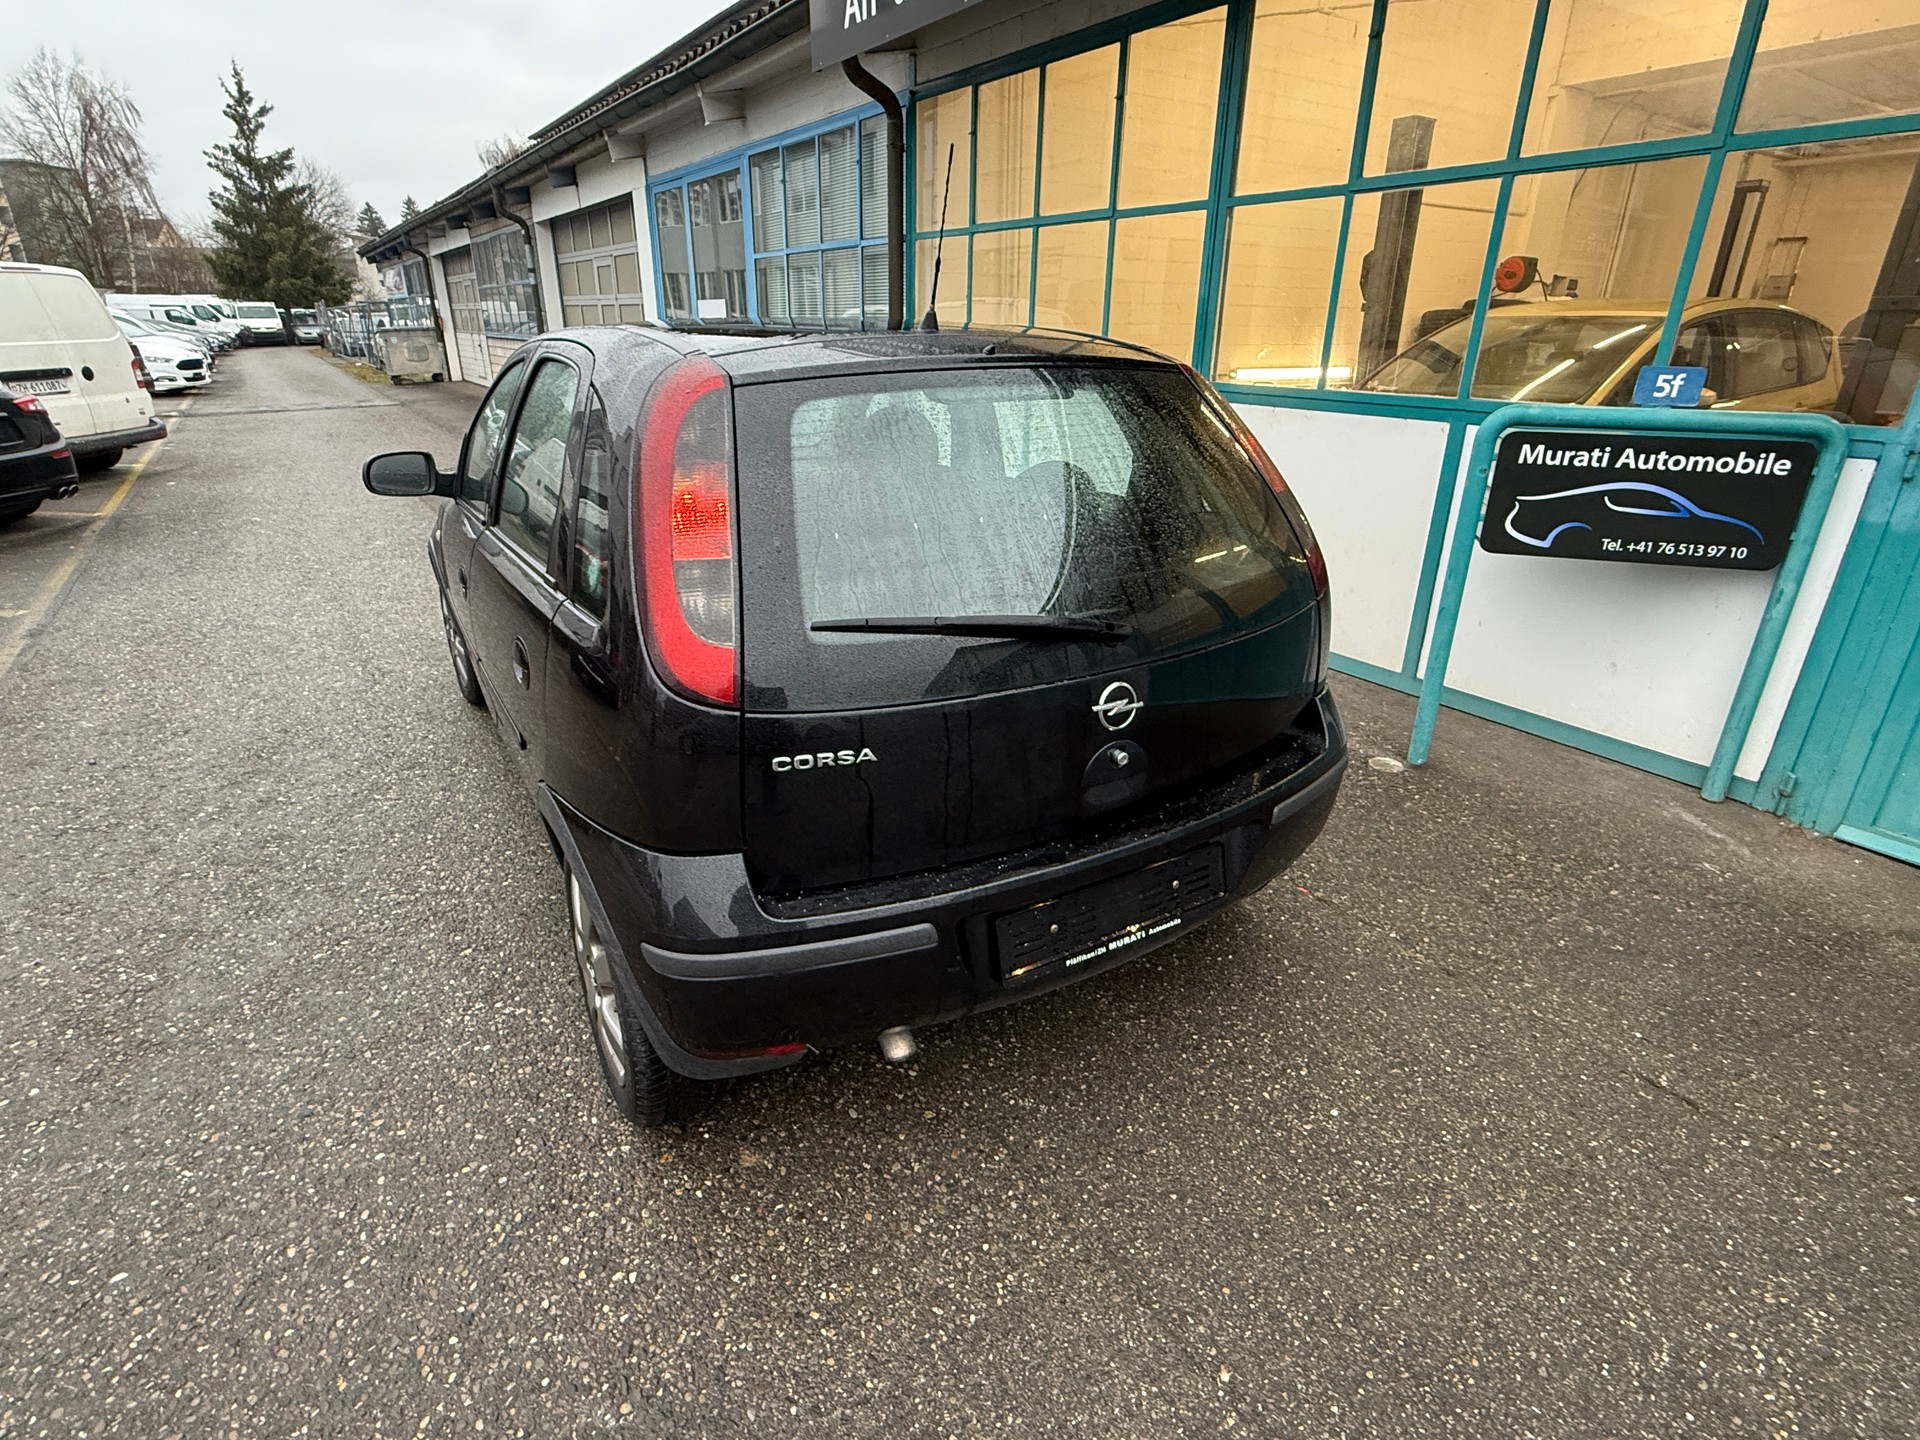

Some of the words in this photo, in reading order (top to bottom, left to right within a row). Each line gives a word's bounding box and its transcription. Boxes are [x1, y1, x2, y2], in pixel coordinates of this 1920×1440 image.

[1652, 373, 1687, 398] 5f
[1517, 443, 1611, 468] Murati
[1614, 447, 1792, 476] Automobile
[1601, 538, 1623, 551] Tel.
[1626, 541, 1653, 553] +41
[1657, 542, 1675, 555] 76
[1676, 544, 1704, 557] 513
[1707, 545, 1726, 558] 97
[1729, 547, 1748, 559] 10
[772, 747, 878, 772] CORSA
[1108, 930, 1146, 950] MURATI
